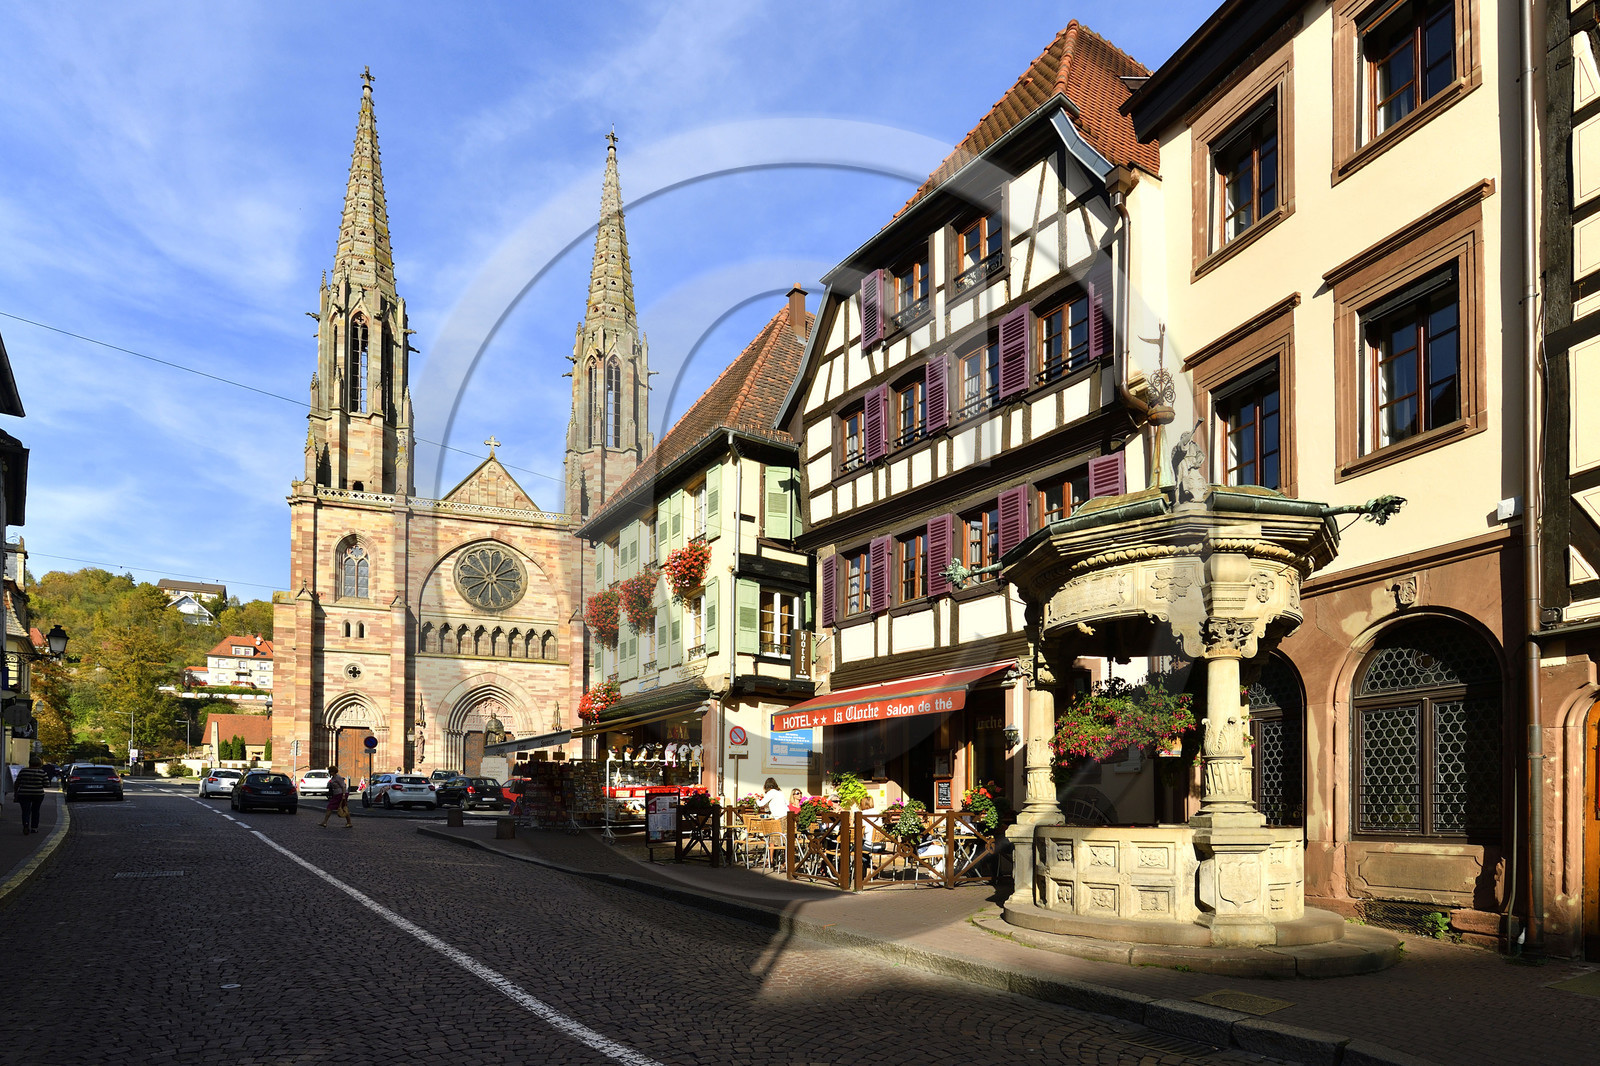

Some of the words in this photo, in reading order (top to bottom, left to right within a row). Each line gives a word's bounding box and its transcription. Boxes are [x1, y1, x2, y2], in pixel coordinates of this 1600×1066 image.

[783, 714, 811, 729] HOTEL
[834, 709, 843, 722] la
[845, 704, 879, 721] Cloche
[886, 703, 914, 716] Salon
[918, 700, 931, 712] de
[935, 697, 953, 710] thé
